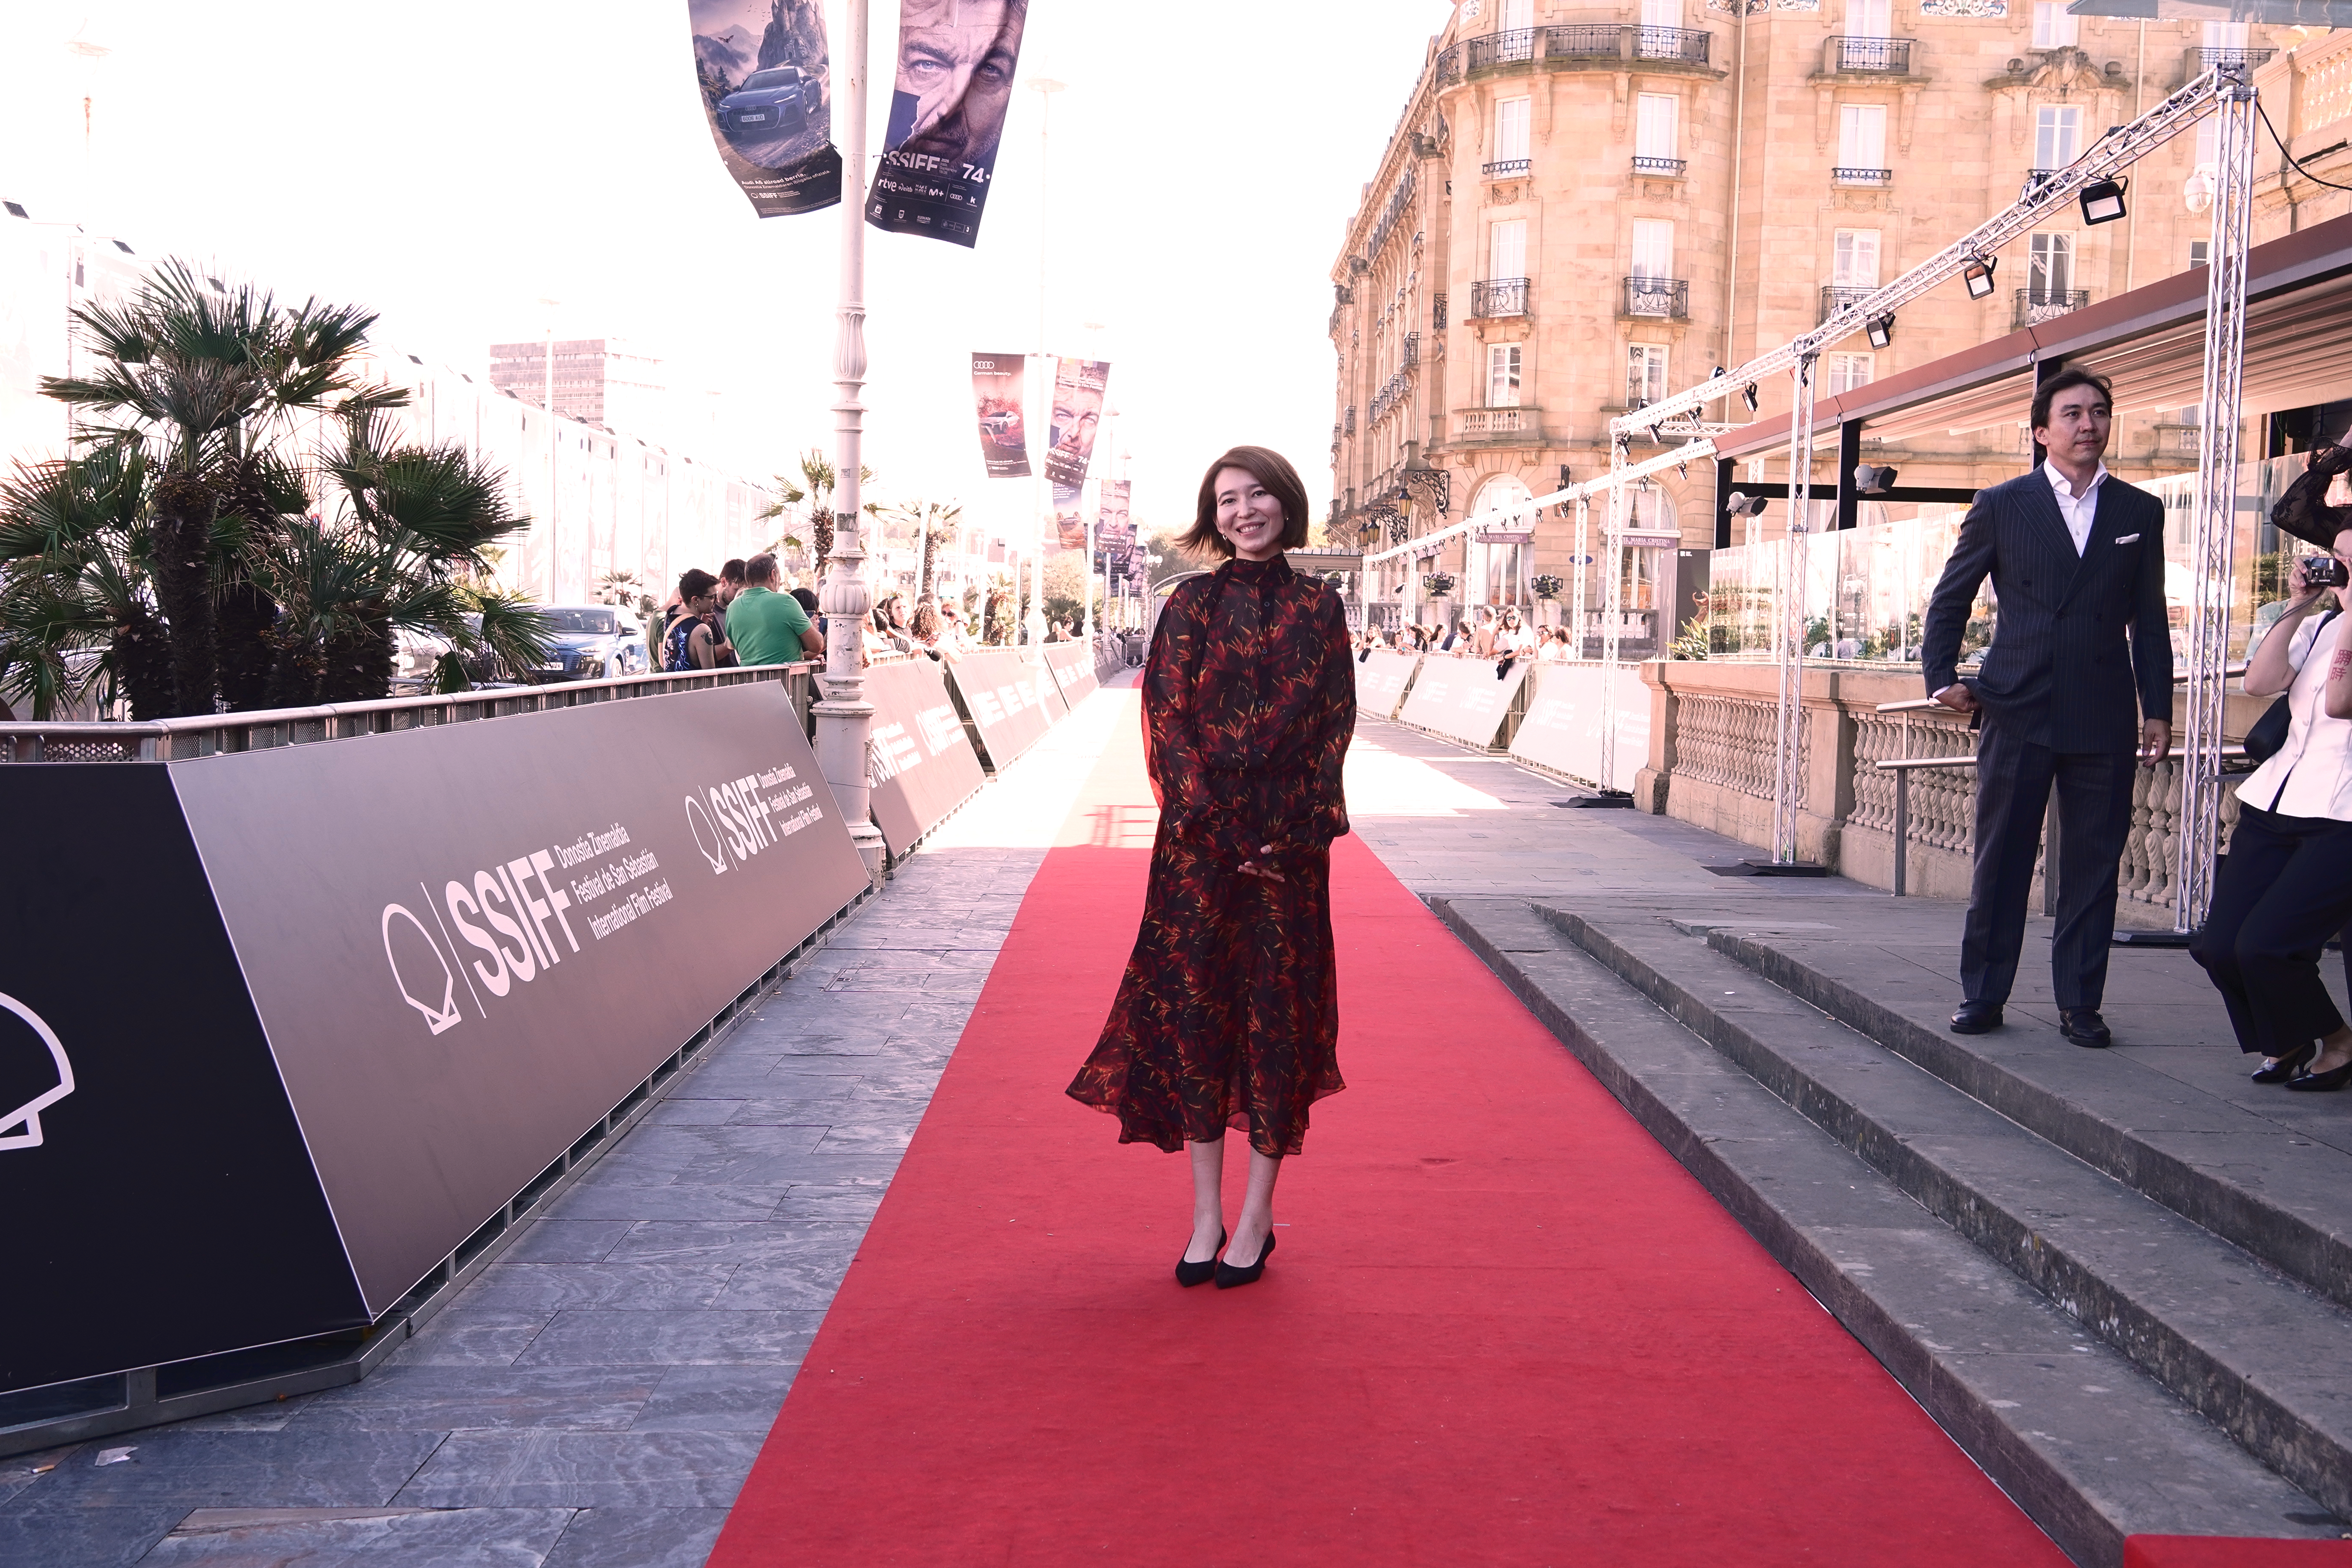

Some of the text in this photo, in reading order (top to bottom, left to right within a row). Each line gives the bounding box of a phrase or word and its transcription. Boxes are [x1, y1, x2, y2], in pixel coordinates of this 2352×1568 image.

[878, 178, 897, 192] rtve
[963, 163, 984, 183] 74
[903, 185, 913, 193] eitb
[1078, 456, 1088, 465] 74
[756, 762, 797, 789] Donostia Zinemaldia
[768, 791, 788, 813] Festival
[782, 791, 791, 807] de
[786, 789, 795, 805] San
[710, 774, 778, 861] SSIFF
[779, 803, 823, 837] International Film Festival
[554, 822, 630, 869] Donostia Zinemaldia
[570, 848, 659, 905] Festival de San Sebastián
[587, 877, 674, 940] International Film Festival
[445, 848, 580, 997] SSIFF
